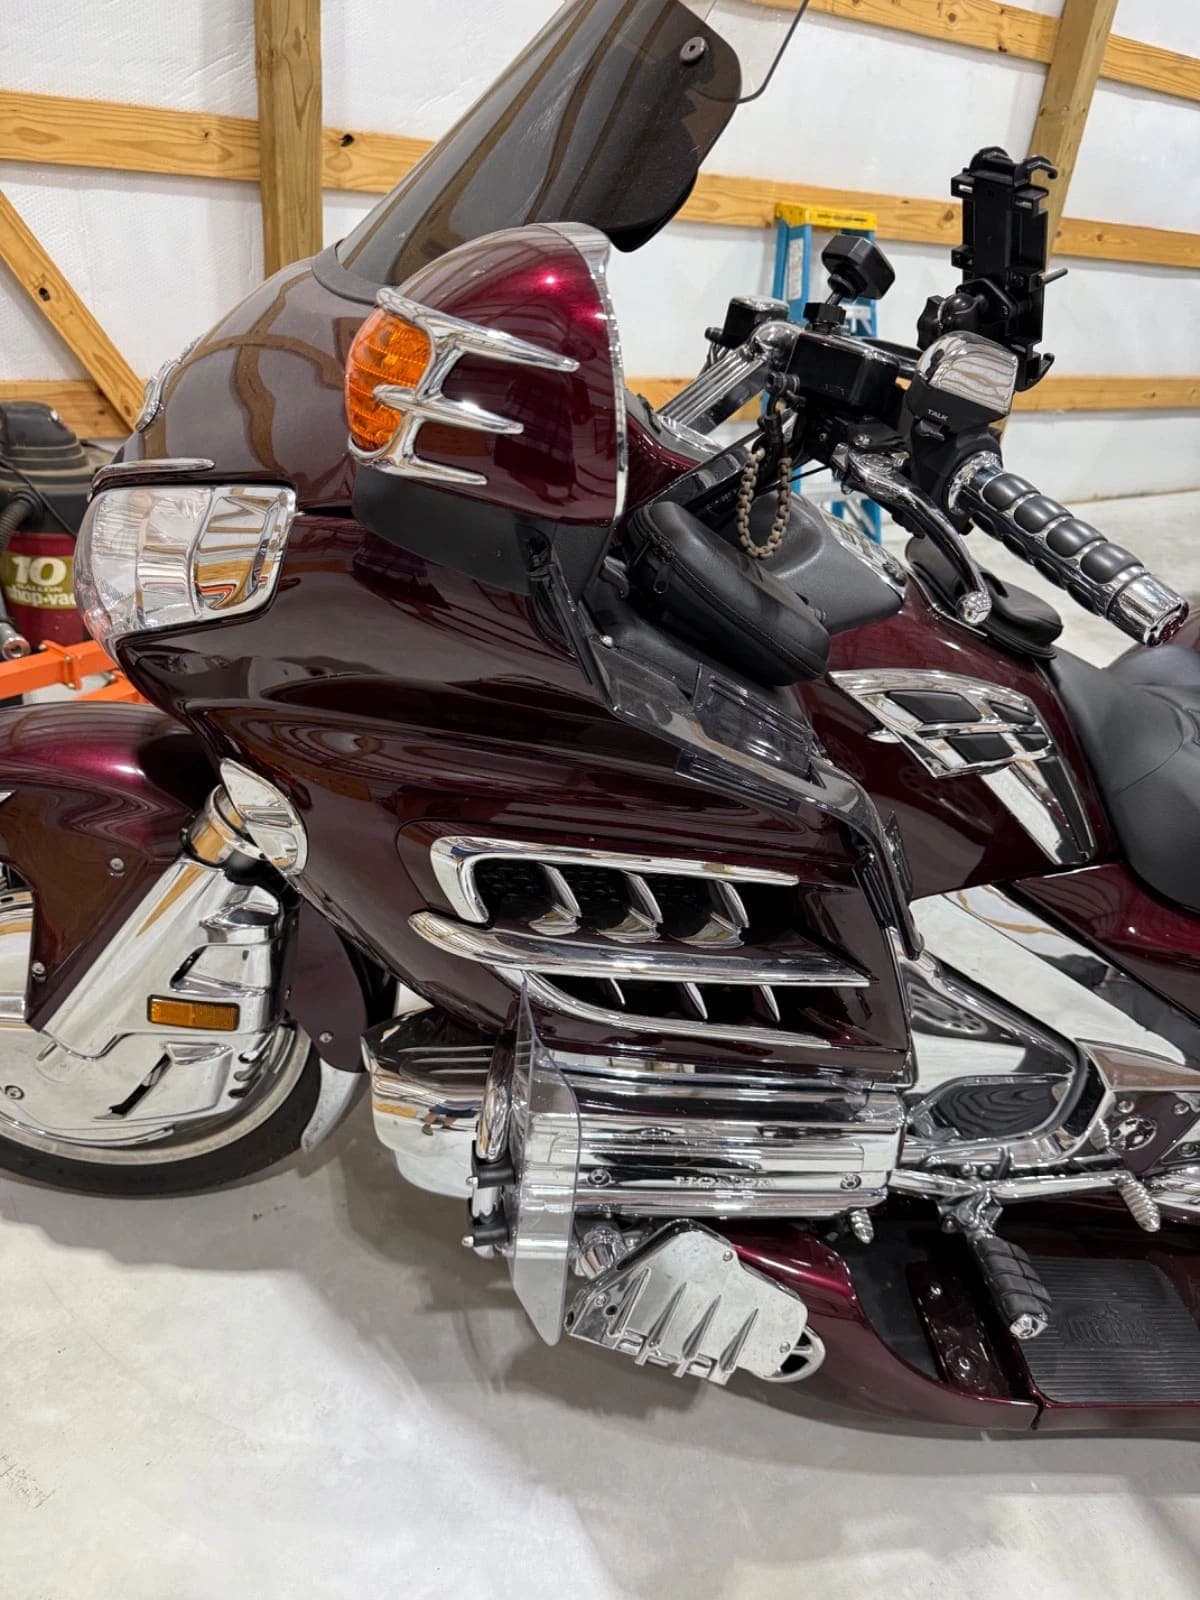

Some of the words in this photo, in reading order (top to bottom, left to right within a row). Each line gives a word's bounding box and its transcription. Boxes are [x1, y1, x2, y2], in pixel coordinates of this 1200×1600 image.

[927, 408, 949, 421] TALK
[12, 556, 67, 586] 10
[673, 1175, 777, 1189] HONDA
